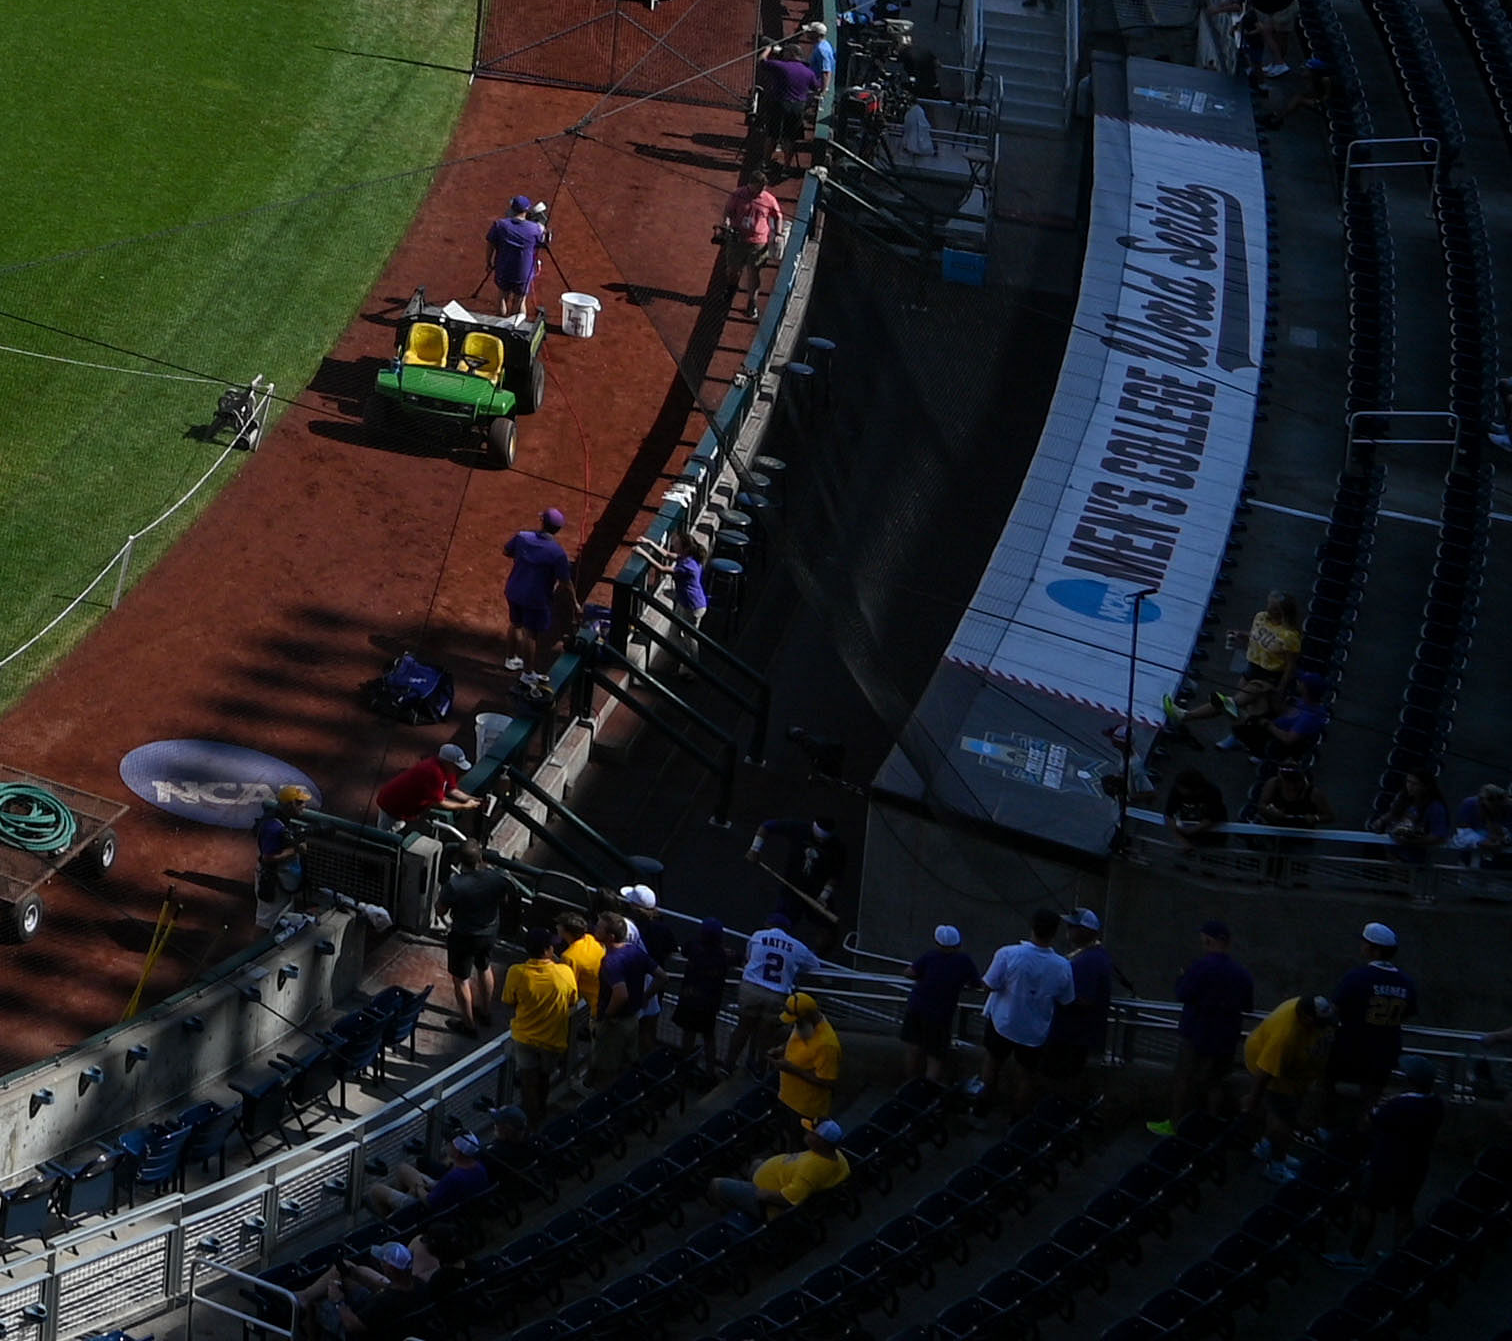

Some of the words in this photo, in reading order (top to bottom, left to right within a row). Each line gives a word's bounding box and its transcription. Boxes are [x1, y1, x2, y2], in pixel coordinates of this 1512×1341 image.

[1116, 181, 1219, 271] Series
[1099, 262, 1217, 368] World
[1099, 365, 1217, 490] COLLEGE
[1062, 481, 1189, 589] MEN'S
[152, 780, 295, 805] NCA
[763, 952, 784, 983] 2
